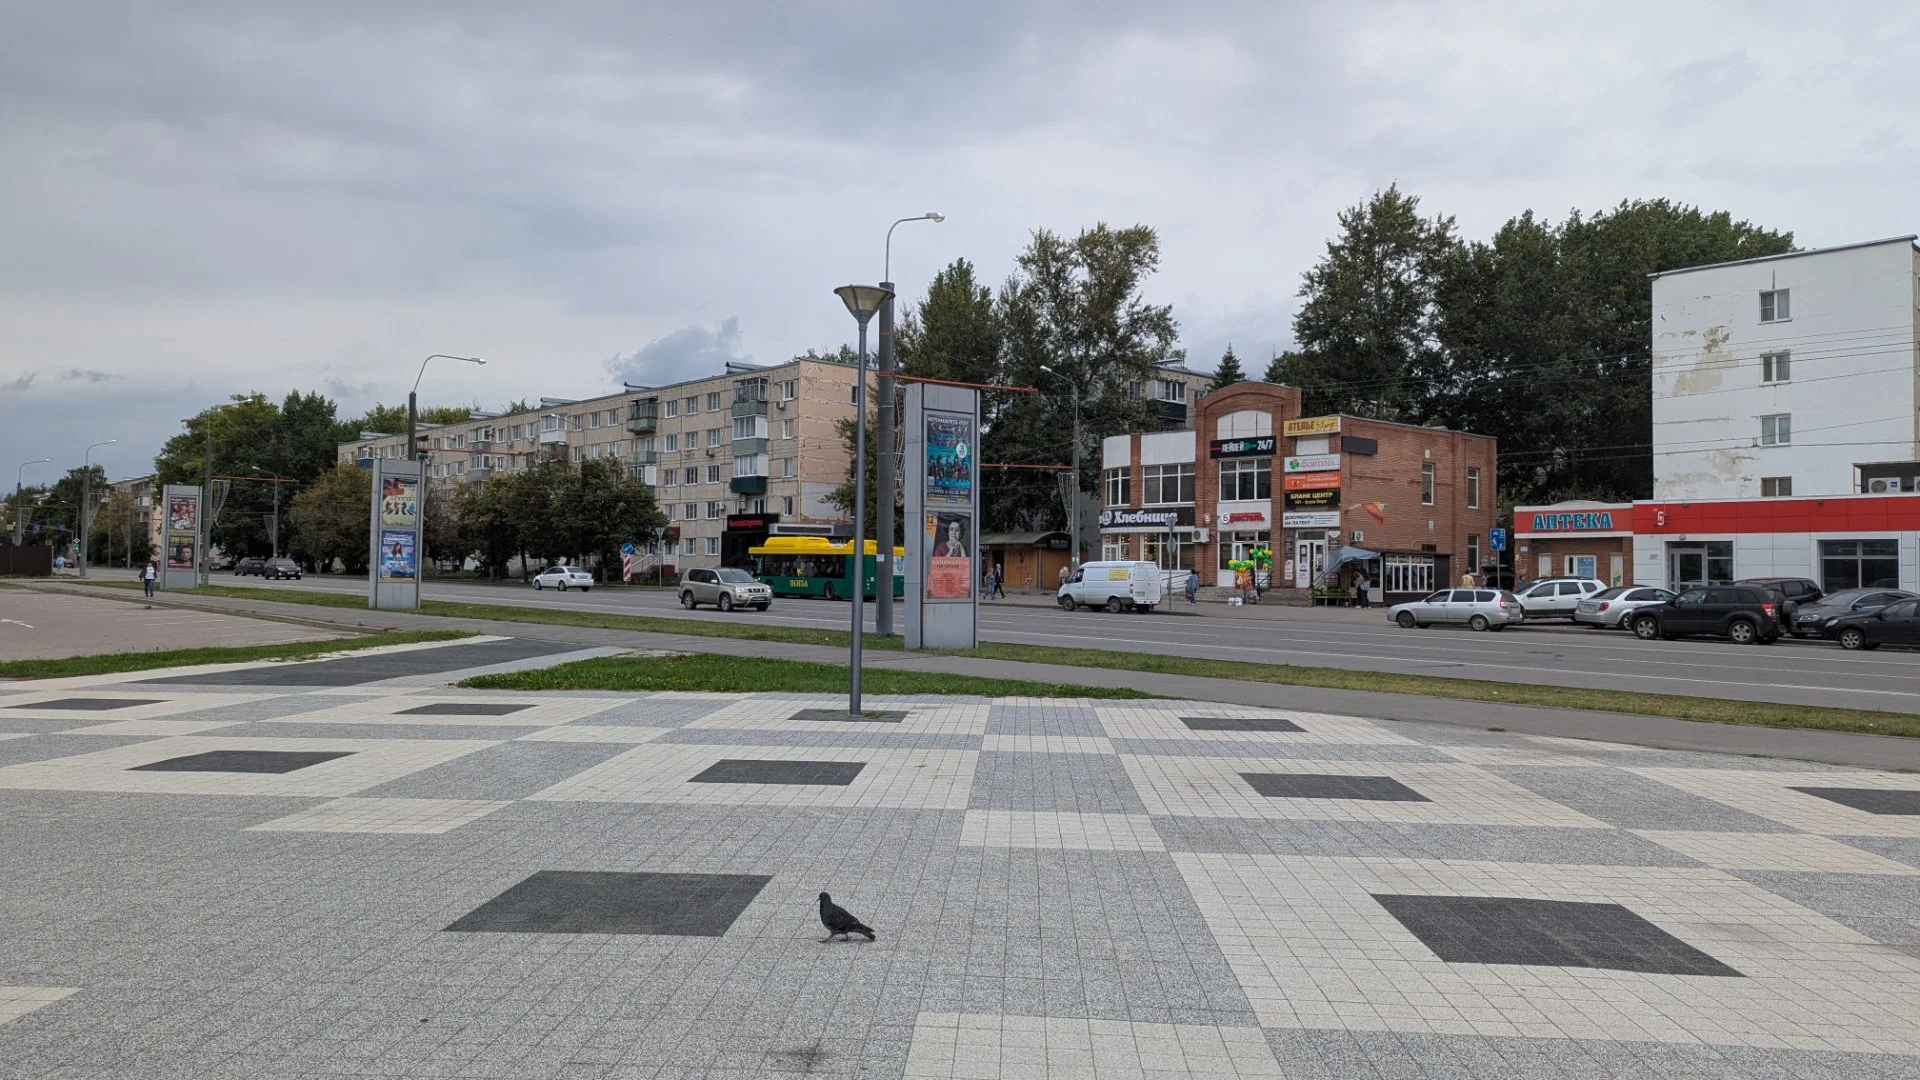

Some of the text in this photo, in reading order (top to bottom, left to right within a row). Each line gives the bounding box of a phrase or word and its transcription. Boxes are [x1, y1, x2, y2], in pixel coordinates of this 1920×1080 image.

[1288, 421, 1314, 432] АТЕЛЬЕ
[1257, 440, 1273, 450] 24/7
[1312, 491, 1333, 499] ЦЕНТР
[1533, 512, 1613, 530] АПТЕКА
